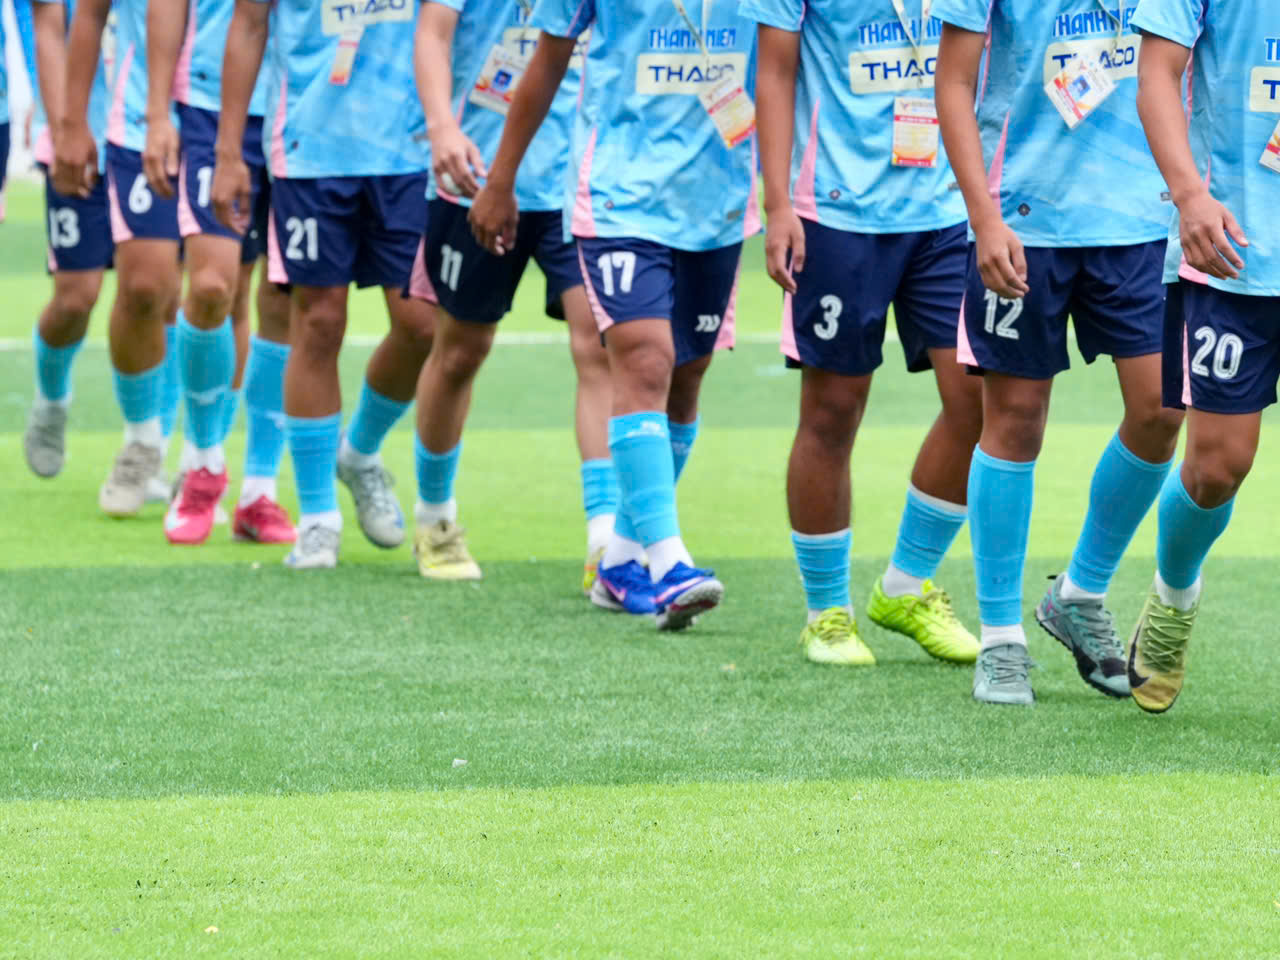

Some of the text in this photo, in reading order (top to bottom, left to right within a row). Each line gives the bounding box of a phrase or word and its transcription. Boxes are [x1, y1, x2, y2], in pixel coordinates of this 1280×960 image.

[649, 28, 703, 48] THAN
[1052, 46, 1135, 69] TACO
[861, 57, 937, 80] THAC
[128, 172, 153, 215] 6
[50, 207, 80, 248] 13
[286, 217, 318, 262] 21
[440, 244, 463, 292] 11
[598, 251, 637, 297] 17
[813, 294, 844, 340] 3
[983, 288, 1024, 340] 12
[1191, 325, 1244, 380] 20
